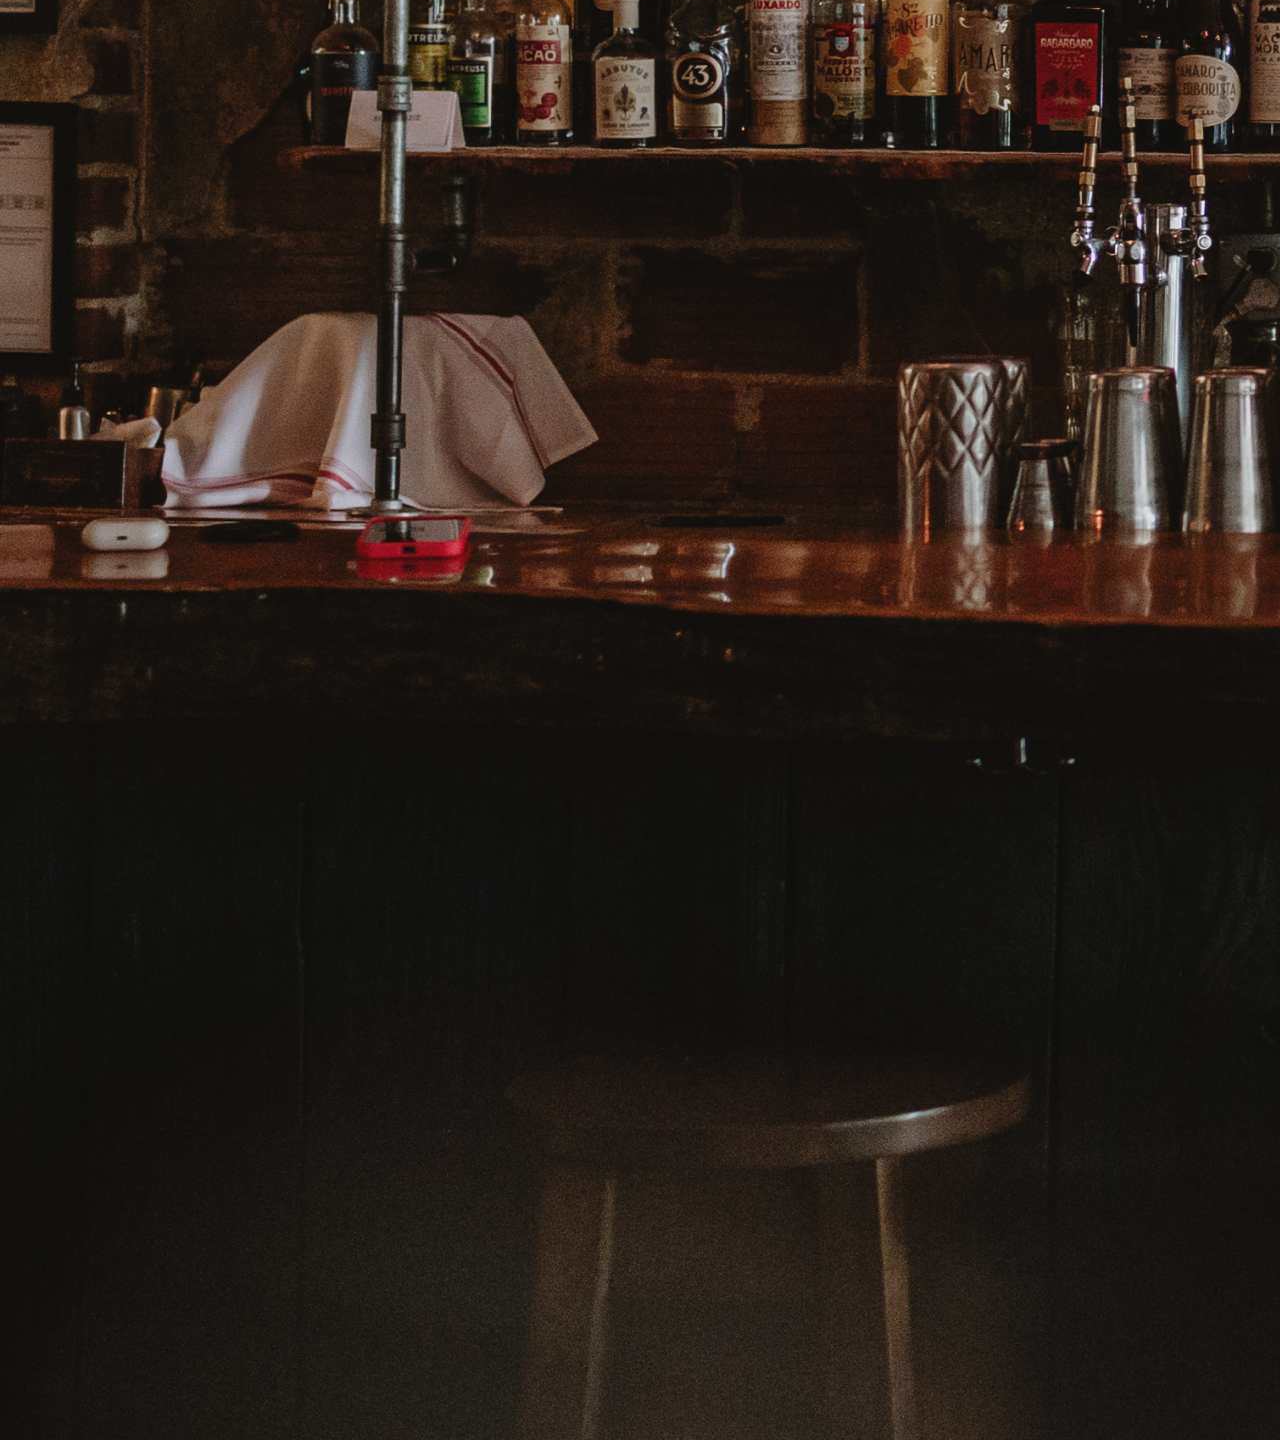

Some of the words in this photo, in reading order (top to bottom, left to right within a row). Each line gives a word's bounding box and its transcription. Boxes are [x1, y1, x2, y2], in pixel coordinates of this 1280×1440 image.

[752, 0, 801, 10] LUXARDO
[600, 64, 650, 80] ARBUTUS
[680, 64, 710, 88] 43
